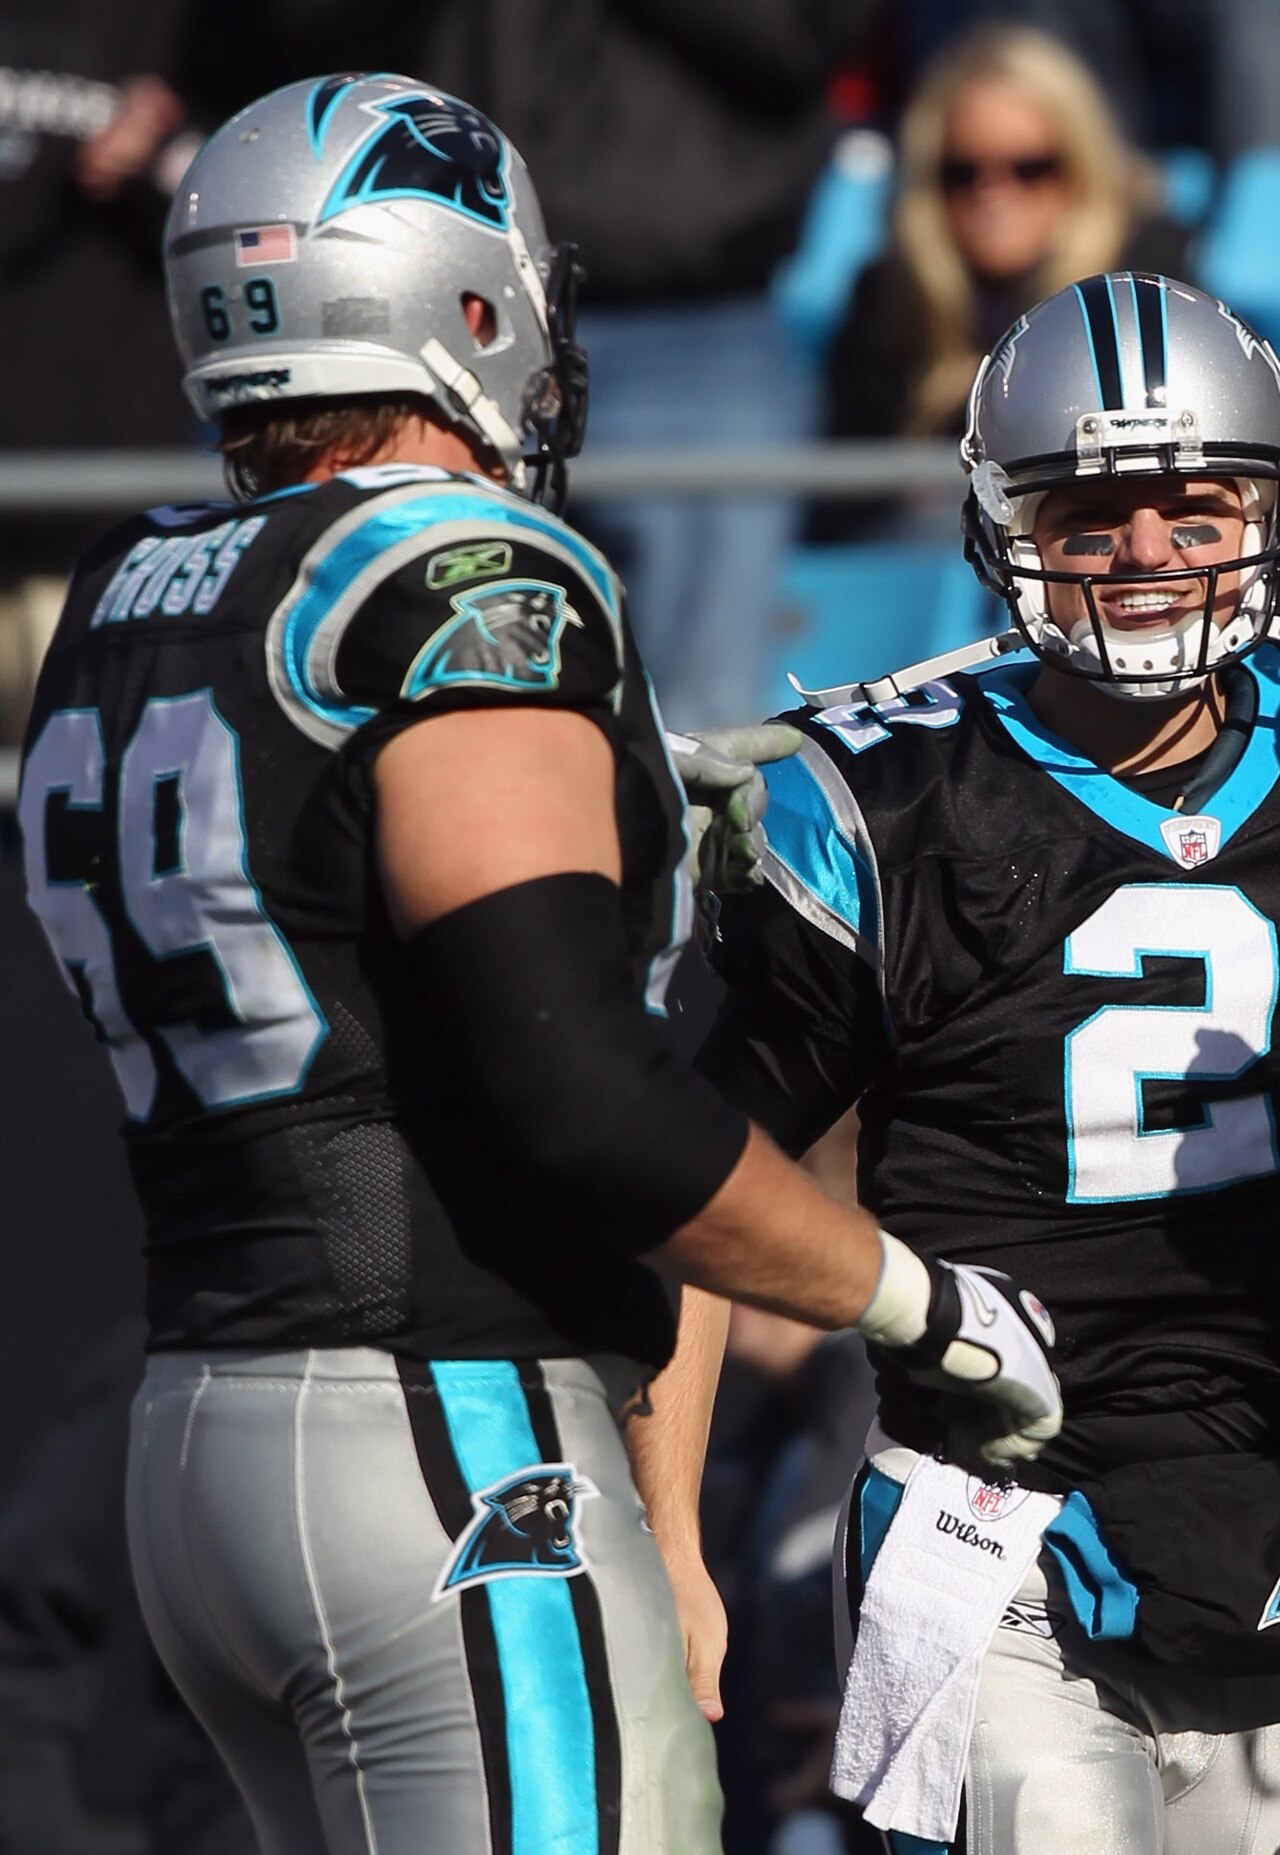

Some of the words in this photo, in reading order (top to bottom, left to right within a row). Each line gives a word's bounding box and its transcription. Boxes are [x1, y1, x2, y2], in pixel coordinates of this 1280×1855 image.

[18, 686, 330, 1124] 69
[974, 1487, 1002, 1514] NFL
[936, 1510, 1006, 1560] Wilson
